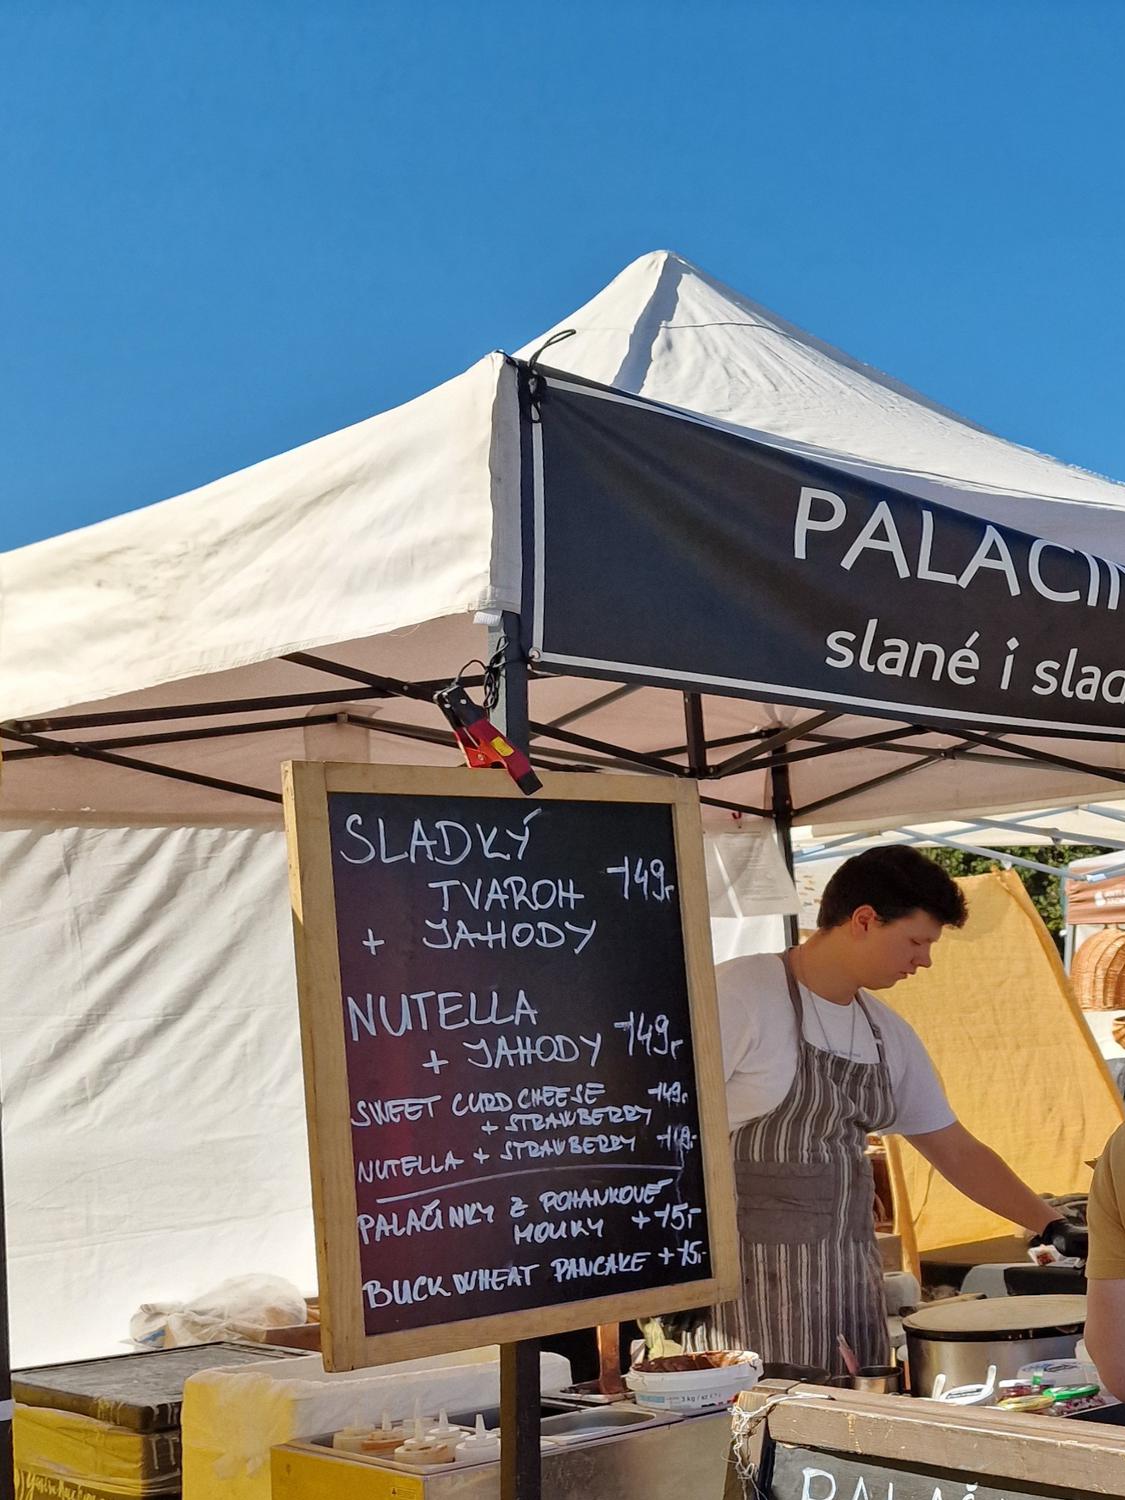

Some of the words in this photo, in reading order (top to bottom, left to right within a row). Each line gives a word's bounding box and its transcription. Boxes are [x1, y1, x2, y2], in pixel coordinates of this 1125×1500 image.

[825, 617, 980, 687] slané
[1000, 636, 1021, 691] i
[339, 807, 544, 865] SLADKÝ
[428, 876, 584, 912] TVAROH
[422, 919, 596, 954] JAHODY
[347, 989, 539, 1042] NUTELLA
[466, 1033, 601, 1070] JAHODY
[350, 1095, 441, 1128] SWEET
[452, 1091, 513, 1117] CURD
[517, 1082, 605, 1109] CHEESE
[505, 1105, 652, 1132] STRAWBERRY
[357, 1150, 464, 1183] NUTELLA
[500, 1135, 636, 1161] STRAWBERRY
[514, 1219, 604, 1246] MOUKY
[550, 1251, 652, 1282] PANCAKE
